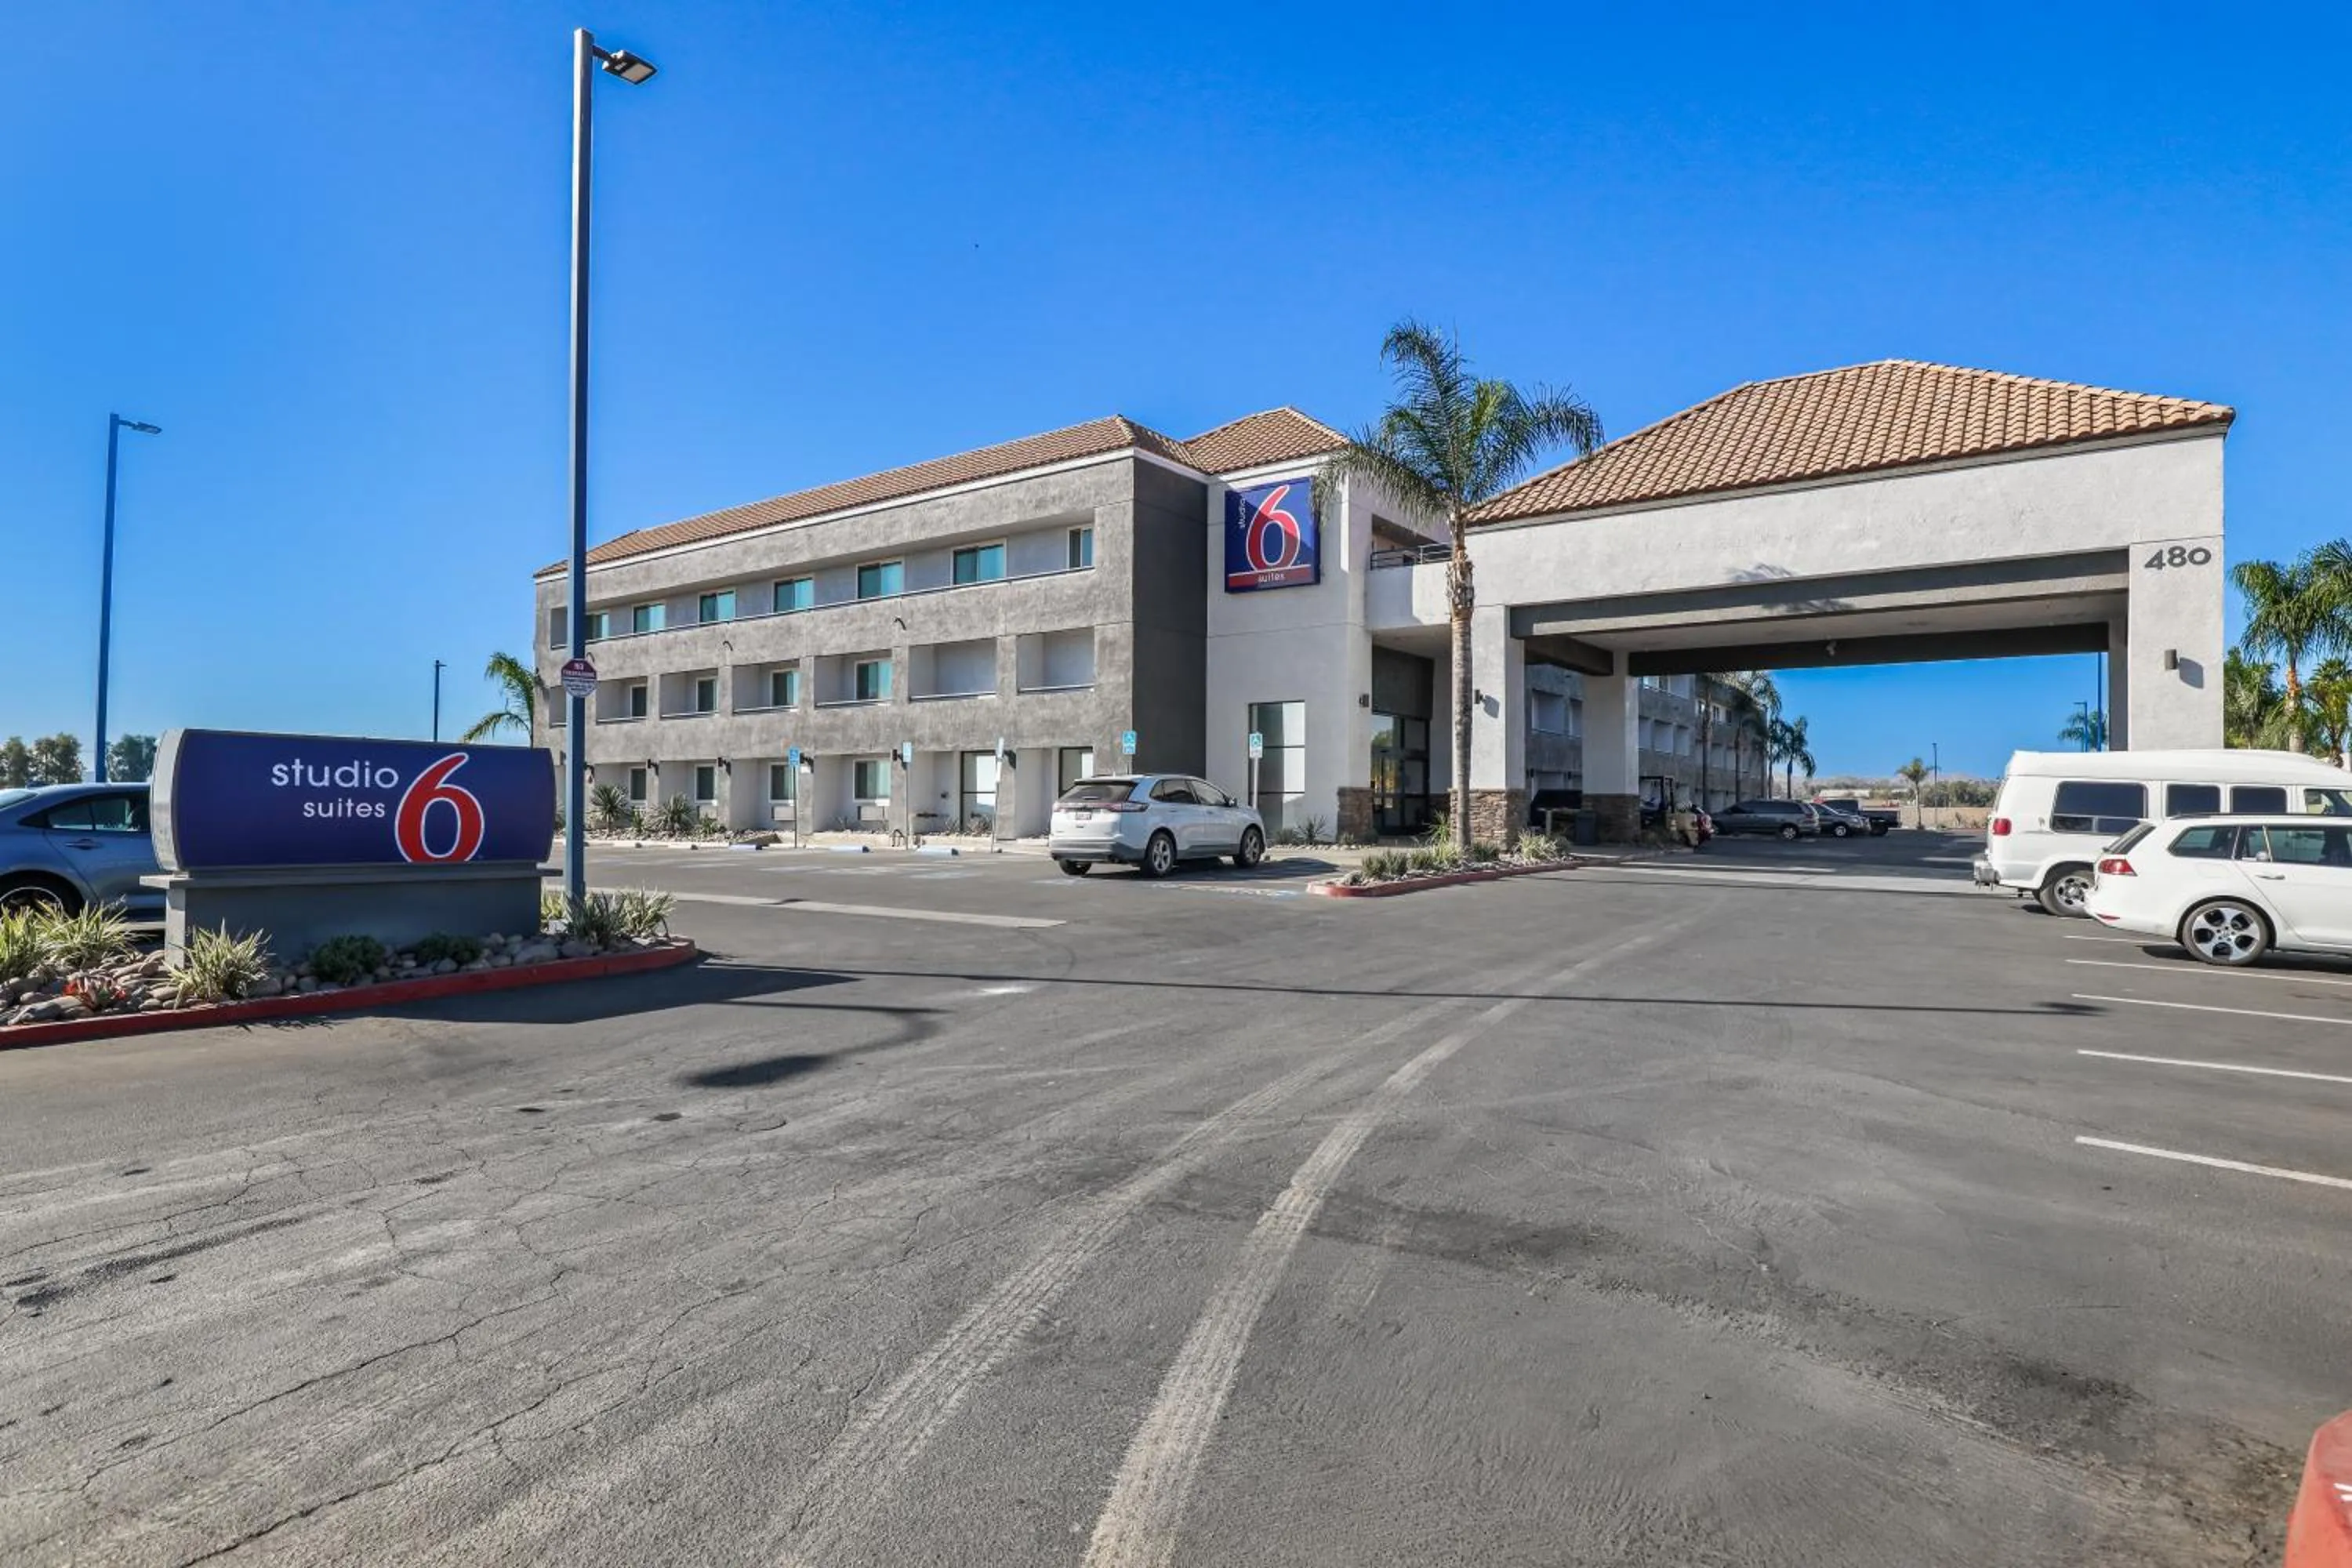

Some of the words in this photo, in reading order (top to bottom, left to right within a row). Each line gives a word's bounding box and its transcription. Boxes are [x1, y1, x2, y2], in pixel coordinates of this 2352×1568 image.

[1238, 498, 1247, 529] studio
[1246, 485, 1301, 571] 6
[2144, 546, 2212, 571] 480
[1258, 573, 1286, 583] suites
[270, 758, 399, 789] studio
[303, 797, 386, 818] suites
[394, 752, 485, 862] 6
